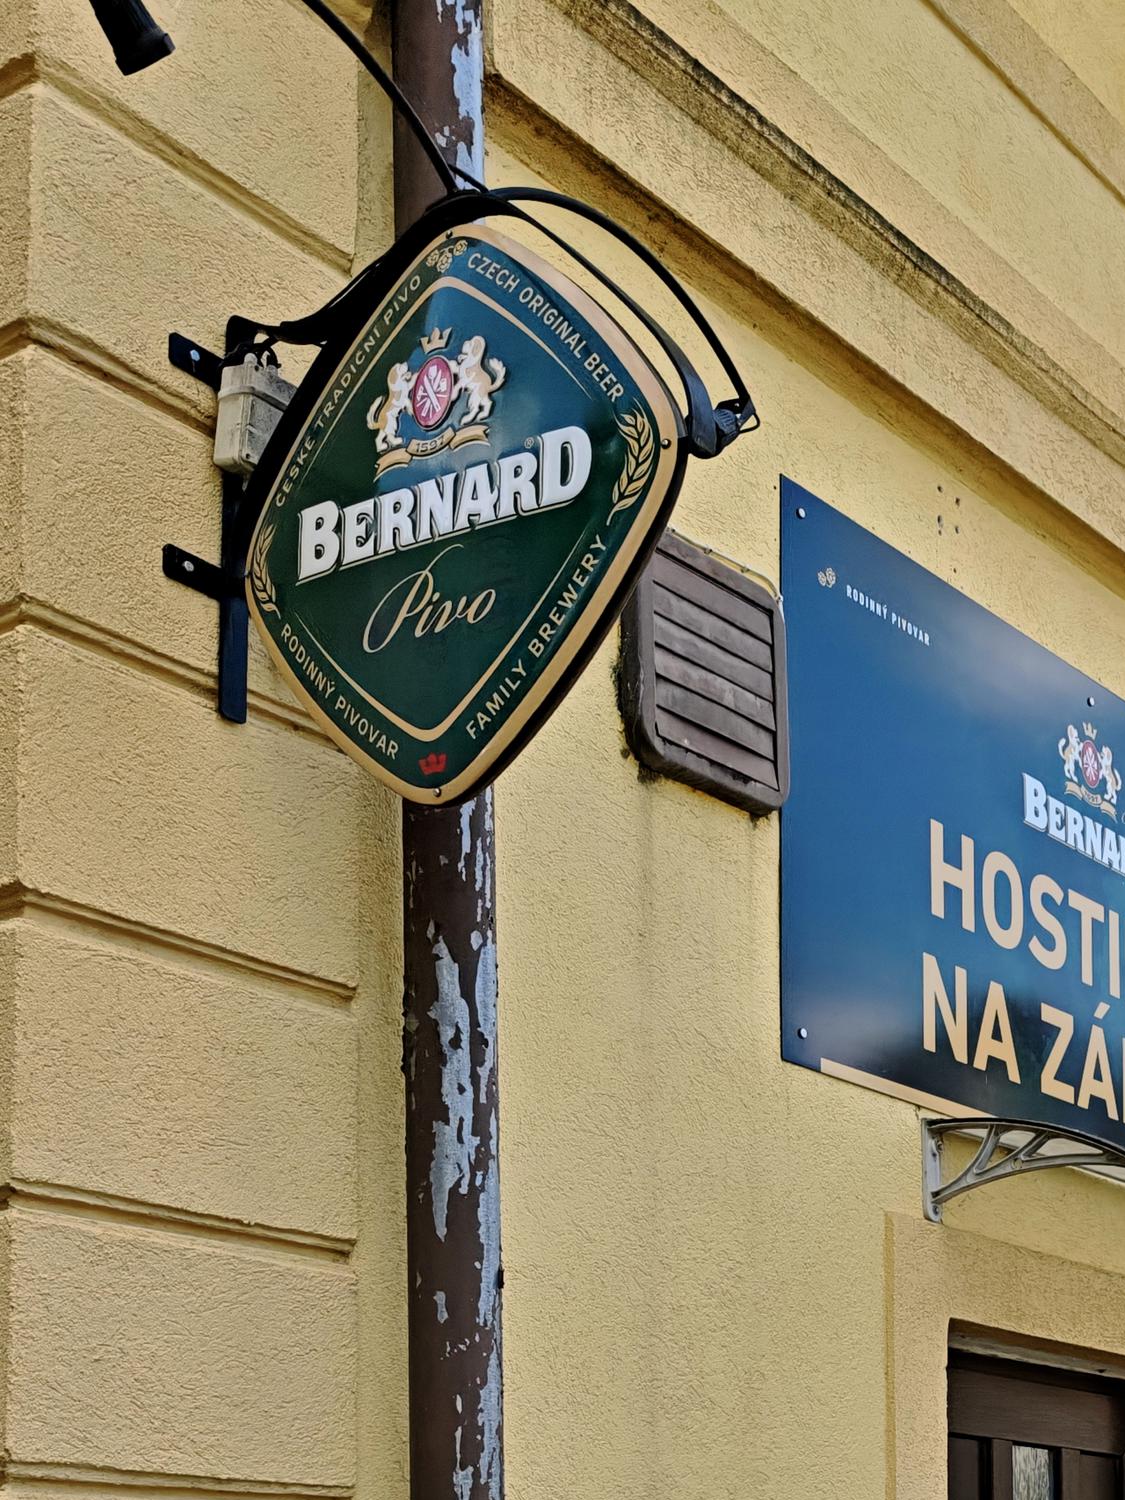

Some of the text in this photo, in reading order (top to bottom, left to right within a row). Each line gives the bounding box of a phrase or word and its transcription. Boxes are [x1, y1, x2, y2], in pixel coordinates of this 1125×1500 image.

[384, 275, 421, 326] PIVO
[467, 253, 624, 402] CZECH ORIGINAL BEER
[296, 426, 592, 586] BERNARD
[416, 435, 444, 452] 1597
[363, 543, 496, 653] Pivo
[466, 534, 607, 740] FAMILY BREWERY
[846, 584, 930, 647] RODINNÝ PIVOVAR
[281, 623, 399, 760] RODINNÝ PIVOVAR
[922, 951, 1021, 1085] NA
